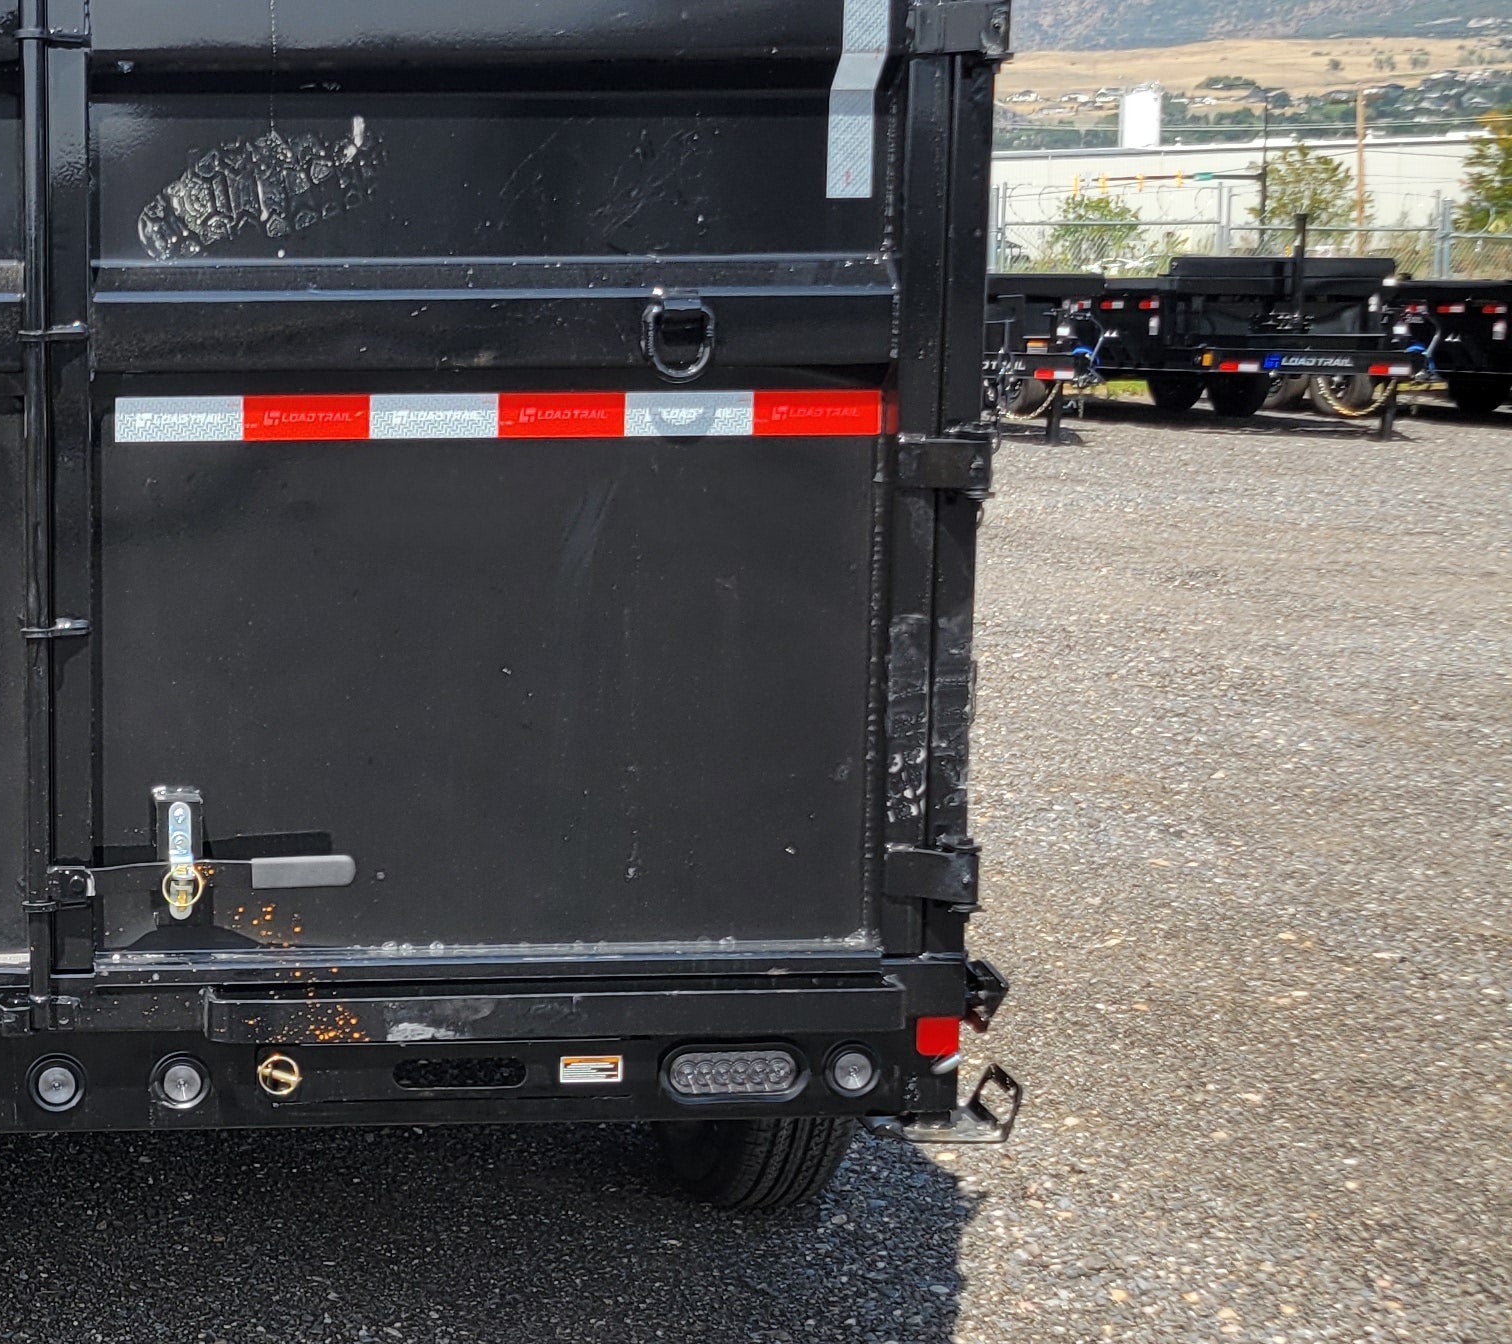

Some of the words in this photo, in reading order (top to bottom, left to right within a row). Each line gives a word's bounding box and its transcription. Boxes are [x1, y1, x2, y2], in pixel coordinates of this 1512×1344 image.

[1281, 356, 1316, 367] LOAD
[1315, 357, 1355, 367] TRAIL
[537, 410, 571, 421] LOAD
[572, 409, 608, 420] TRAIL
[789, 407, 822, 418] LOAD
[824, 407, 860, 418] TRAIL
[281, 413, 316, 424] LOAD
[316, 413, 353, 423] TRAIL
